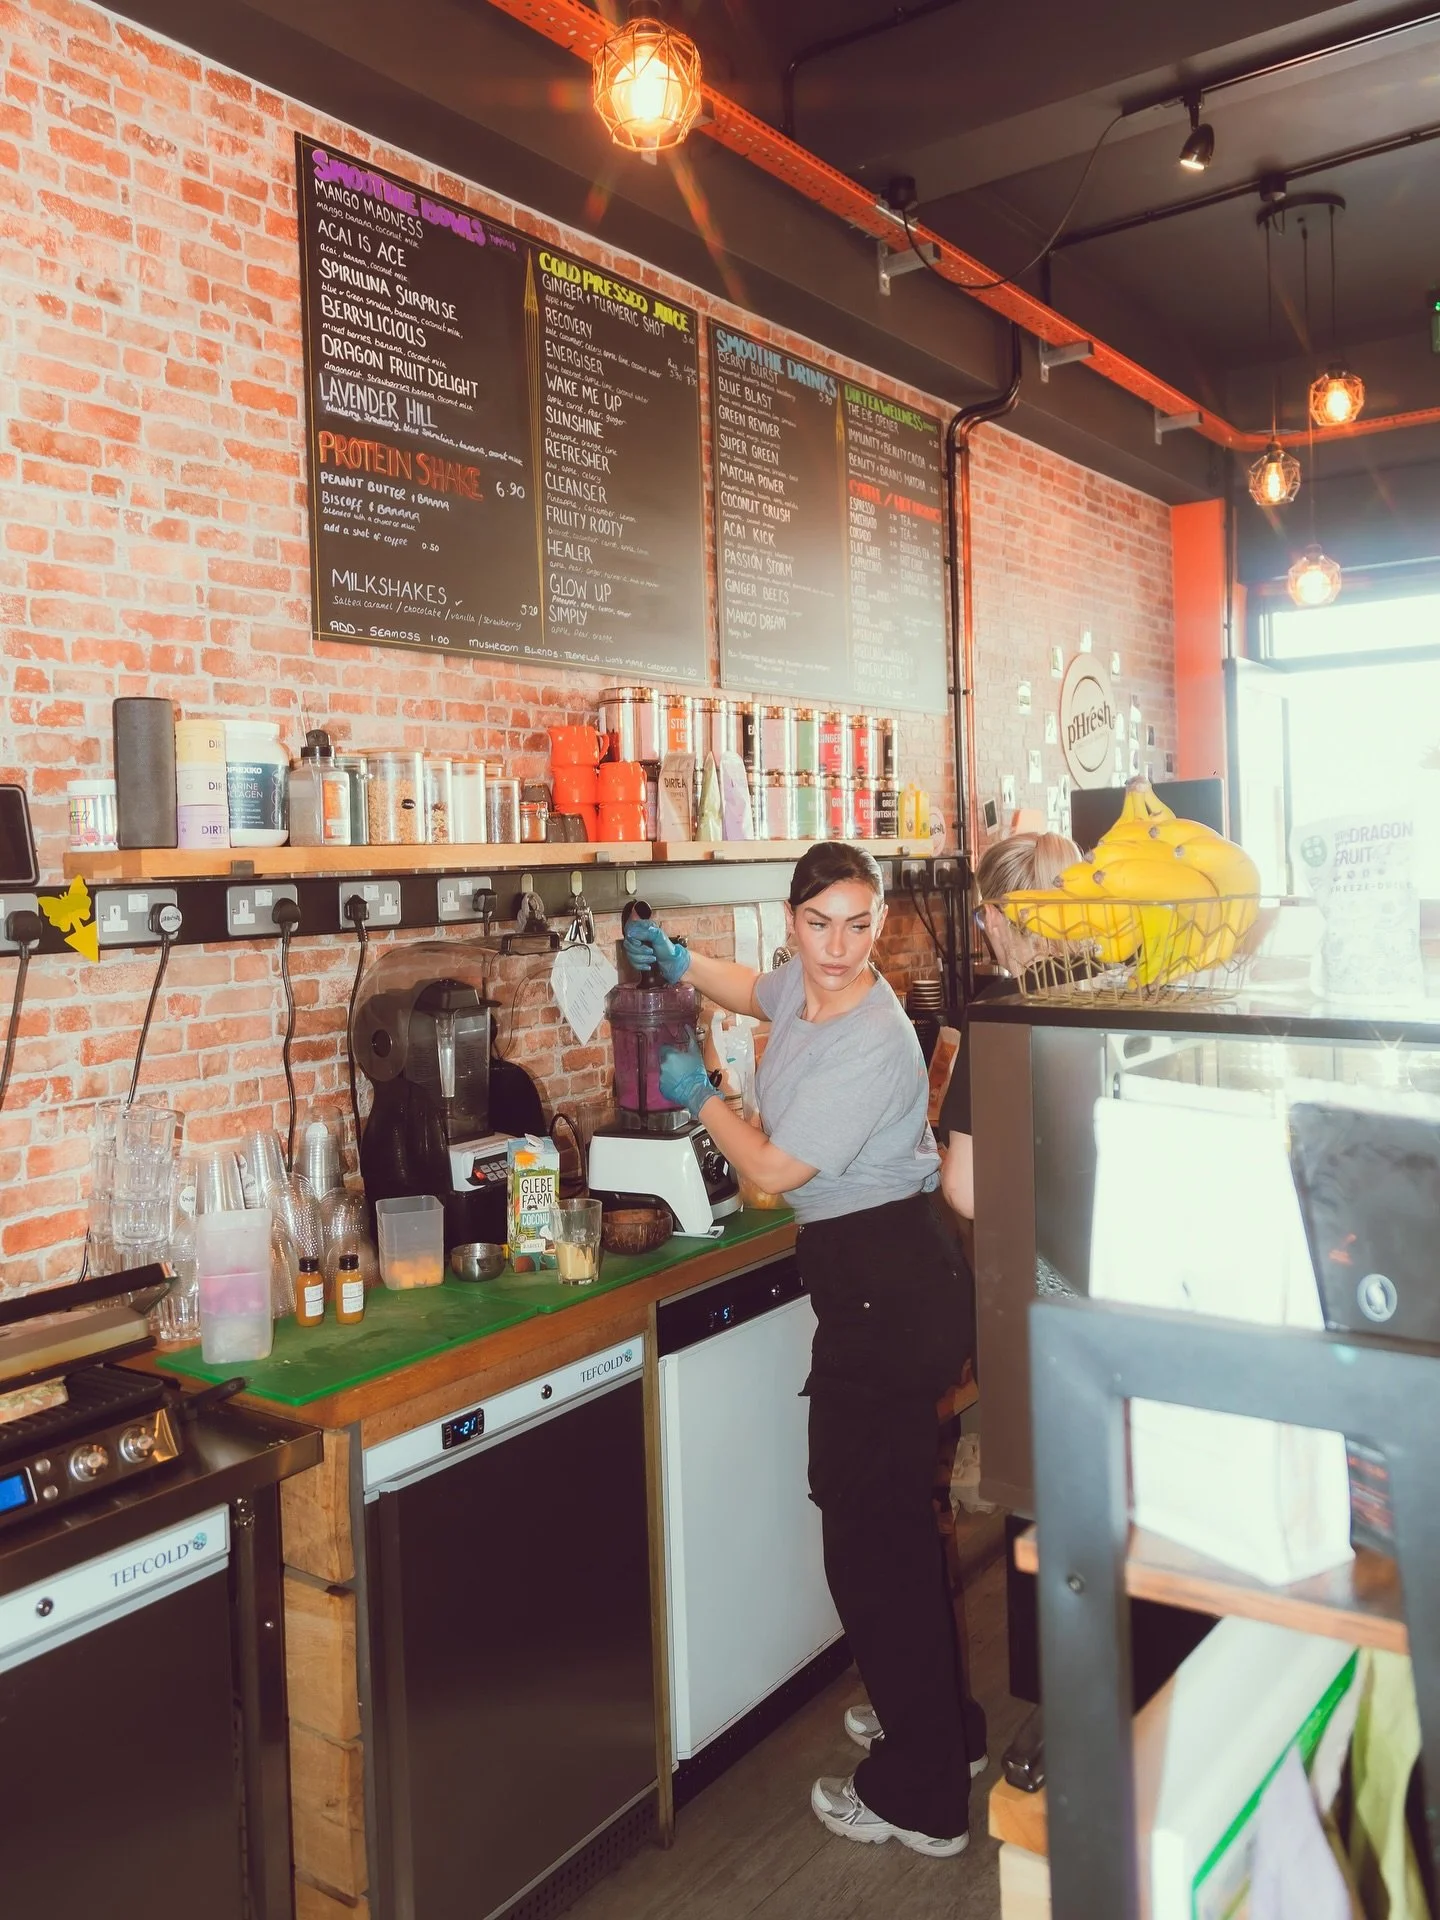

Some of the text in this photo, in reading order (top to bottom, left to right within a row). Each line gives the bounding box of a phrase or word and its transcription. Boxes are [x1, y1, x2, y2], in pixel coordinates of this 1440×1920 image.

[312, 150, 419, 217] SMOOTHIE
[315, 179, 423, 238] MANGO MADNESS
[318, 220, 406, 267] ACAI IS ACE
[319, 258, 458, 321] SPIRULINA SURPRISE
[322, 282, 337, 295] blue
[539, 252, 690, 333] COLD PRESSED JUICE
[322, 295, 426, 348] BERRYLICIOUS
[542, 274, 665, 338] GINGER TURMERIC SHOT
[323, 322, 344, 337] mixed
[545, 307, 593, 339] RECOVERY
[322, 334, 478, 398] DRAGON FRUIT DELIGHT
[545, 341, 604, 376] ENERGISER
[716, 329, 784, 374] SMOOTHIE
[786, 359, 837, 398] DRINKS
[751, 362, 778, 384] BURST
[319, 373, 438, 428] LAVENDER HILL
[545, 372, 622, 412] WAKE ME UP
[718, 376, 741, 397] BLUE
[745, 386, 772, 410] BLAST
[545, 406, 604, 439] SUNSHINE
[718, 404, 746, 427] GREEN
[848, 402, 861, 417] THE
[318, 431, 413, 481] PROTEIN
[415, 453, 484, 501] SHAKE
[545, 438, 611, 474] REFRESHER
[719, 434, 748, 456] SUPER
[752, 445, 778, 466] GREEN
[320, 471, 364, 488] PEANUT
[368, 481, 407, 501] BUTTER
[545, 472, 608, 504] CLEANSER
[720, 462, 756, 486] MATCHA
[758, 474, 785, 495] POWER
[323, 507, 351, 518] blended
[546, 505, 623, 538] FRUITY ROOTY
[721, 491, 760, 514] COCONUT
[762, 503, 791, 523] CRUSH
[324, 523, 340, 534] add
[353, 528, 370, 539] shot
[373, 532, 381, 541] of
[384, 535, 408, 547] coffee
[724, 521, 776, 548] ACAI KICK
[547, 538, 593, 564] HEALER
[725, 548, 762, 571] PASSION
[766, 558, 792, 577] STORM
[332, 568, 447, 605] MILKSHAKES
[550, 573, 611, 602] GLOW UP
[725, 578, 756, 596] GINGER
[763, 587, 789, 605] BEETS
[333, 595, 362, 607] Salted
[364, 601, 393, 610] caramel
[404, 605, 442, 618] chocolate
[549, 605, 587, 626] SIMPLY
[727, 608, 756, 627] MANGO
[370, 626, 421, 642] SEAMOSS
[1350, 821, 1414, 843] DRAGON
[1335, 846, 1374, 867] FRUIT
[521, 1177, 553, 1194] GLEBE
[522, 1193, 553, 1209] FARM
[522, 1213, 550, 1226] COCONU
[580, 1355, 623, 1383] TEFCOLD
[110, 1542, 189, 1587] TEFCOLD
